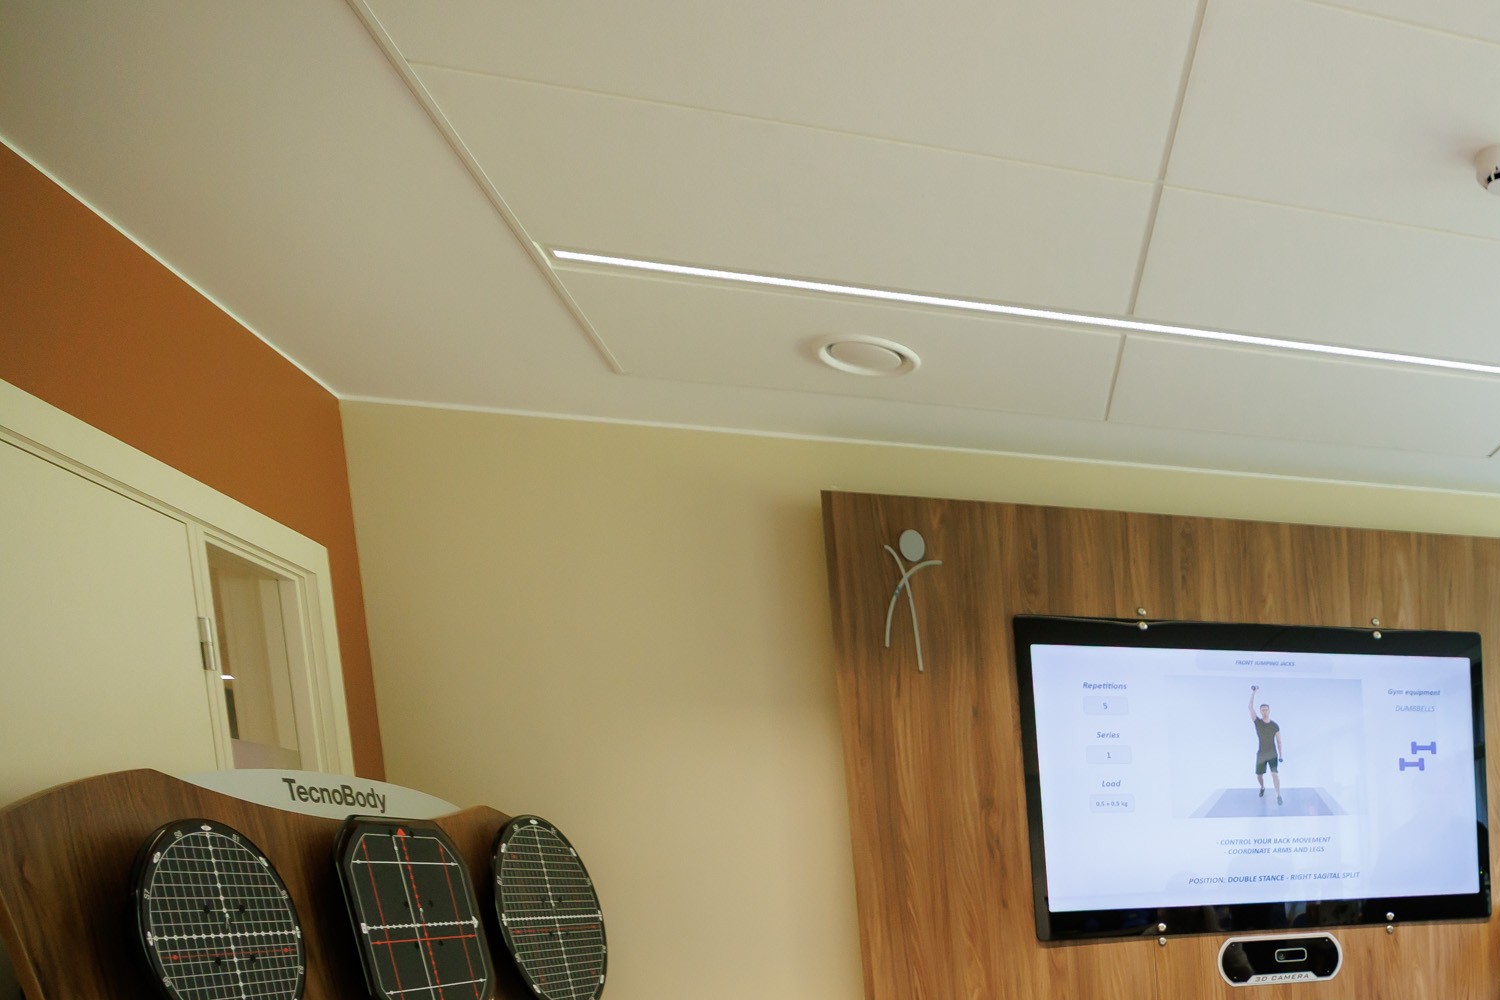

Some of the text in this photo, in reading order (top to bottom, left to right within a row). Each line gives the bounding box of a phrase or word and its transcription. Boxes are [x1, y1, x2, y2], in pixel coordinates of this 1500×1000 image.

[1082, 681, 1127, 690] Repetitions
[1387, 688, 1441, 697] Gym equipment
[1395, 704, 1436, 713] DUMBBELLS
[1096, 731, 1120, 739] Series
[1101, 779, 1122, 788] Load
[281, 777, 386, 814] TecnoBody
[1220, 838, 1252, 846] CONTROL
[1253, 837, 1272, 845] YOUR
[1273, 837, 1291, 845] BACK
[1292, 836, 1332, 844] MOVEMENT
[1228, 847, 1271, 855] COORDINATE
[1272, 846, 1292, 854] ARMS
[1227, 875, 1257, 883] DOUBLE
[1258, 874, 1285, 882] STANCE
[1290, 873, 1312, 881] RIGHT
[1313, 872, 1341, 880] SAGITAL
[1341, 871, 1361, 879] SPLIT
[1270, 973, 1310, 981] CAMERA
